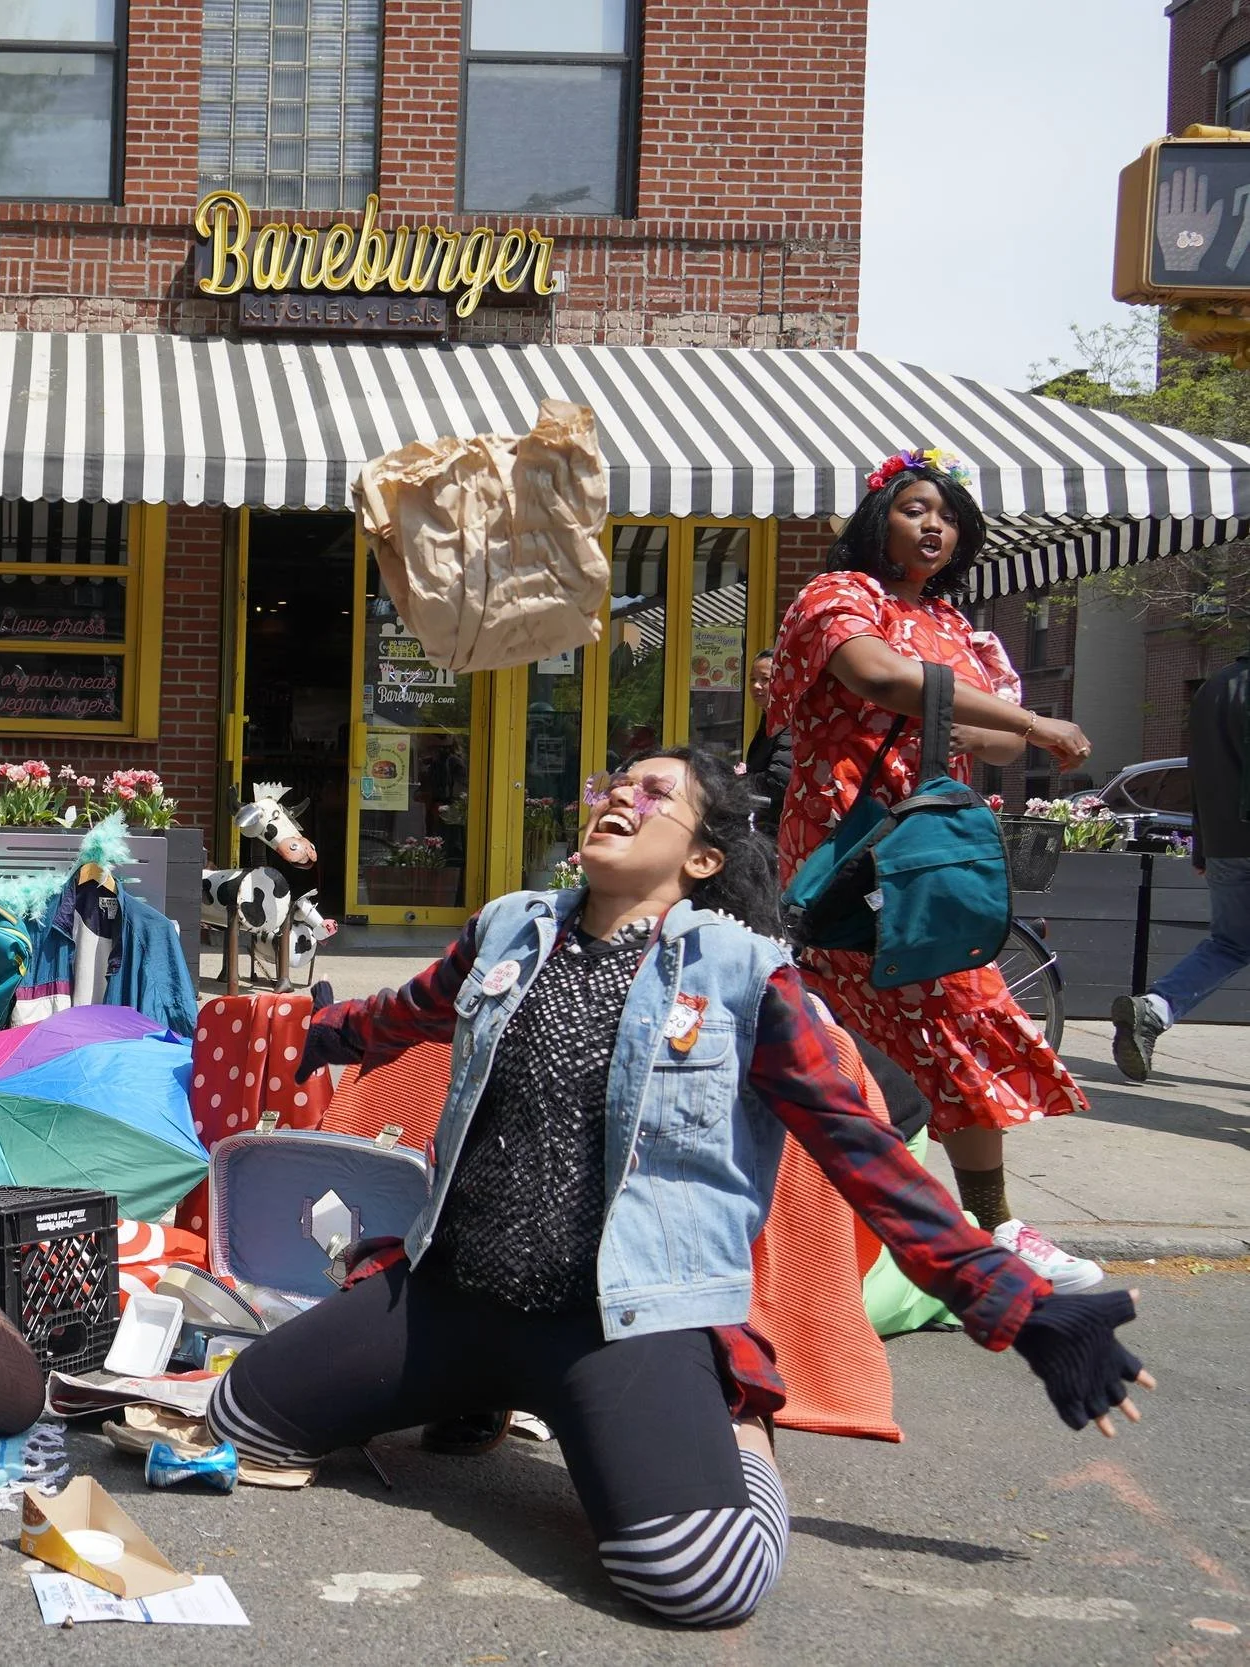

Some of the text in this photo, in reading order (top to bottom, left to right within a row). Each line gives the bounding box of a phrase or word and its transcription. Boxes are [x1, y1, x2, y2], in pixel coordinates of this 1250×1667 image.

[195, 190, 558, 319] Bareburger
[243, 299, 359, 322] KITCHEN
[388, 302, 442, 324] BAR
[11, 614, 49, 633] love
[51, 617, 107, 640] grass
[1, 669, 65, 693] organic
[67, 671, 117, 690] meats
[50, 694, 115, 718] burgers
[36, 1212, 58, 1222] Roberts
